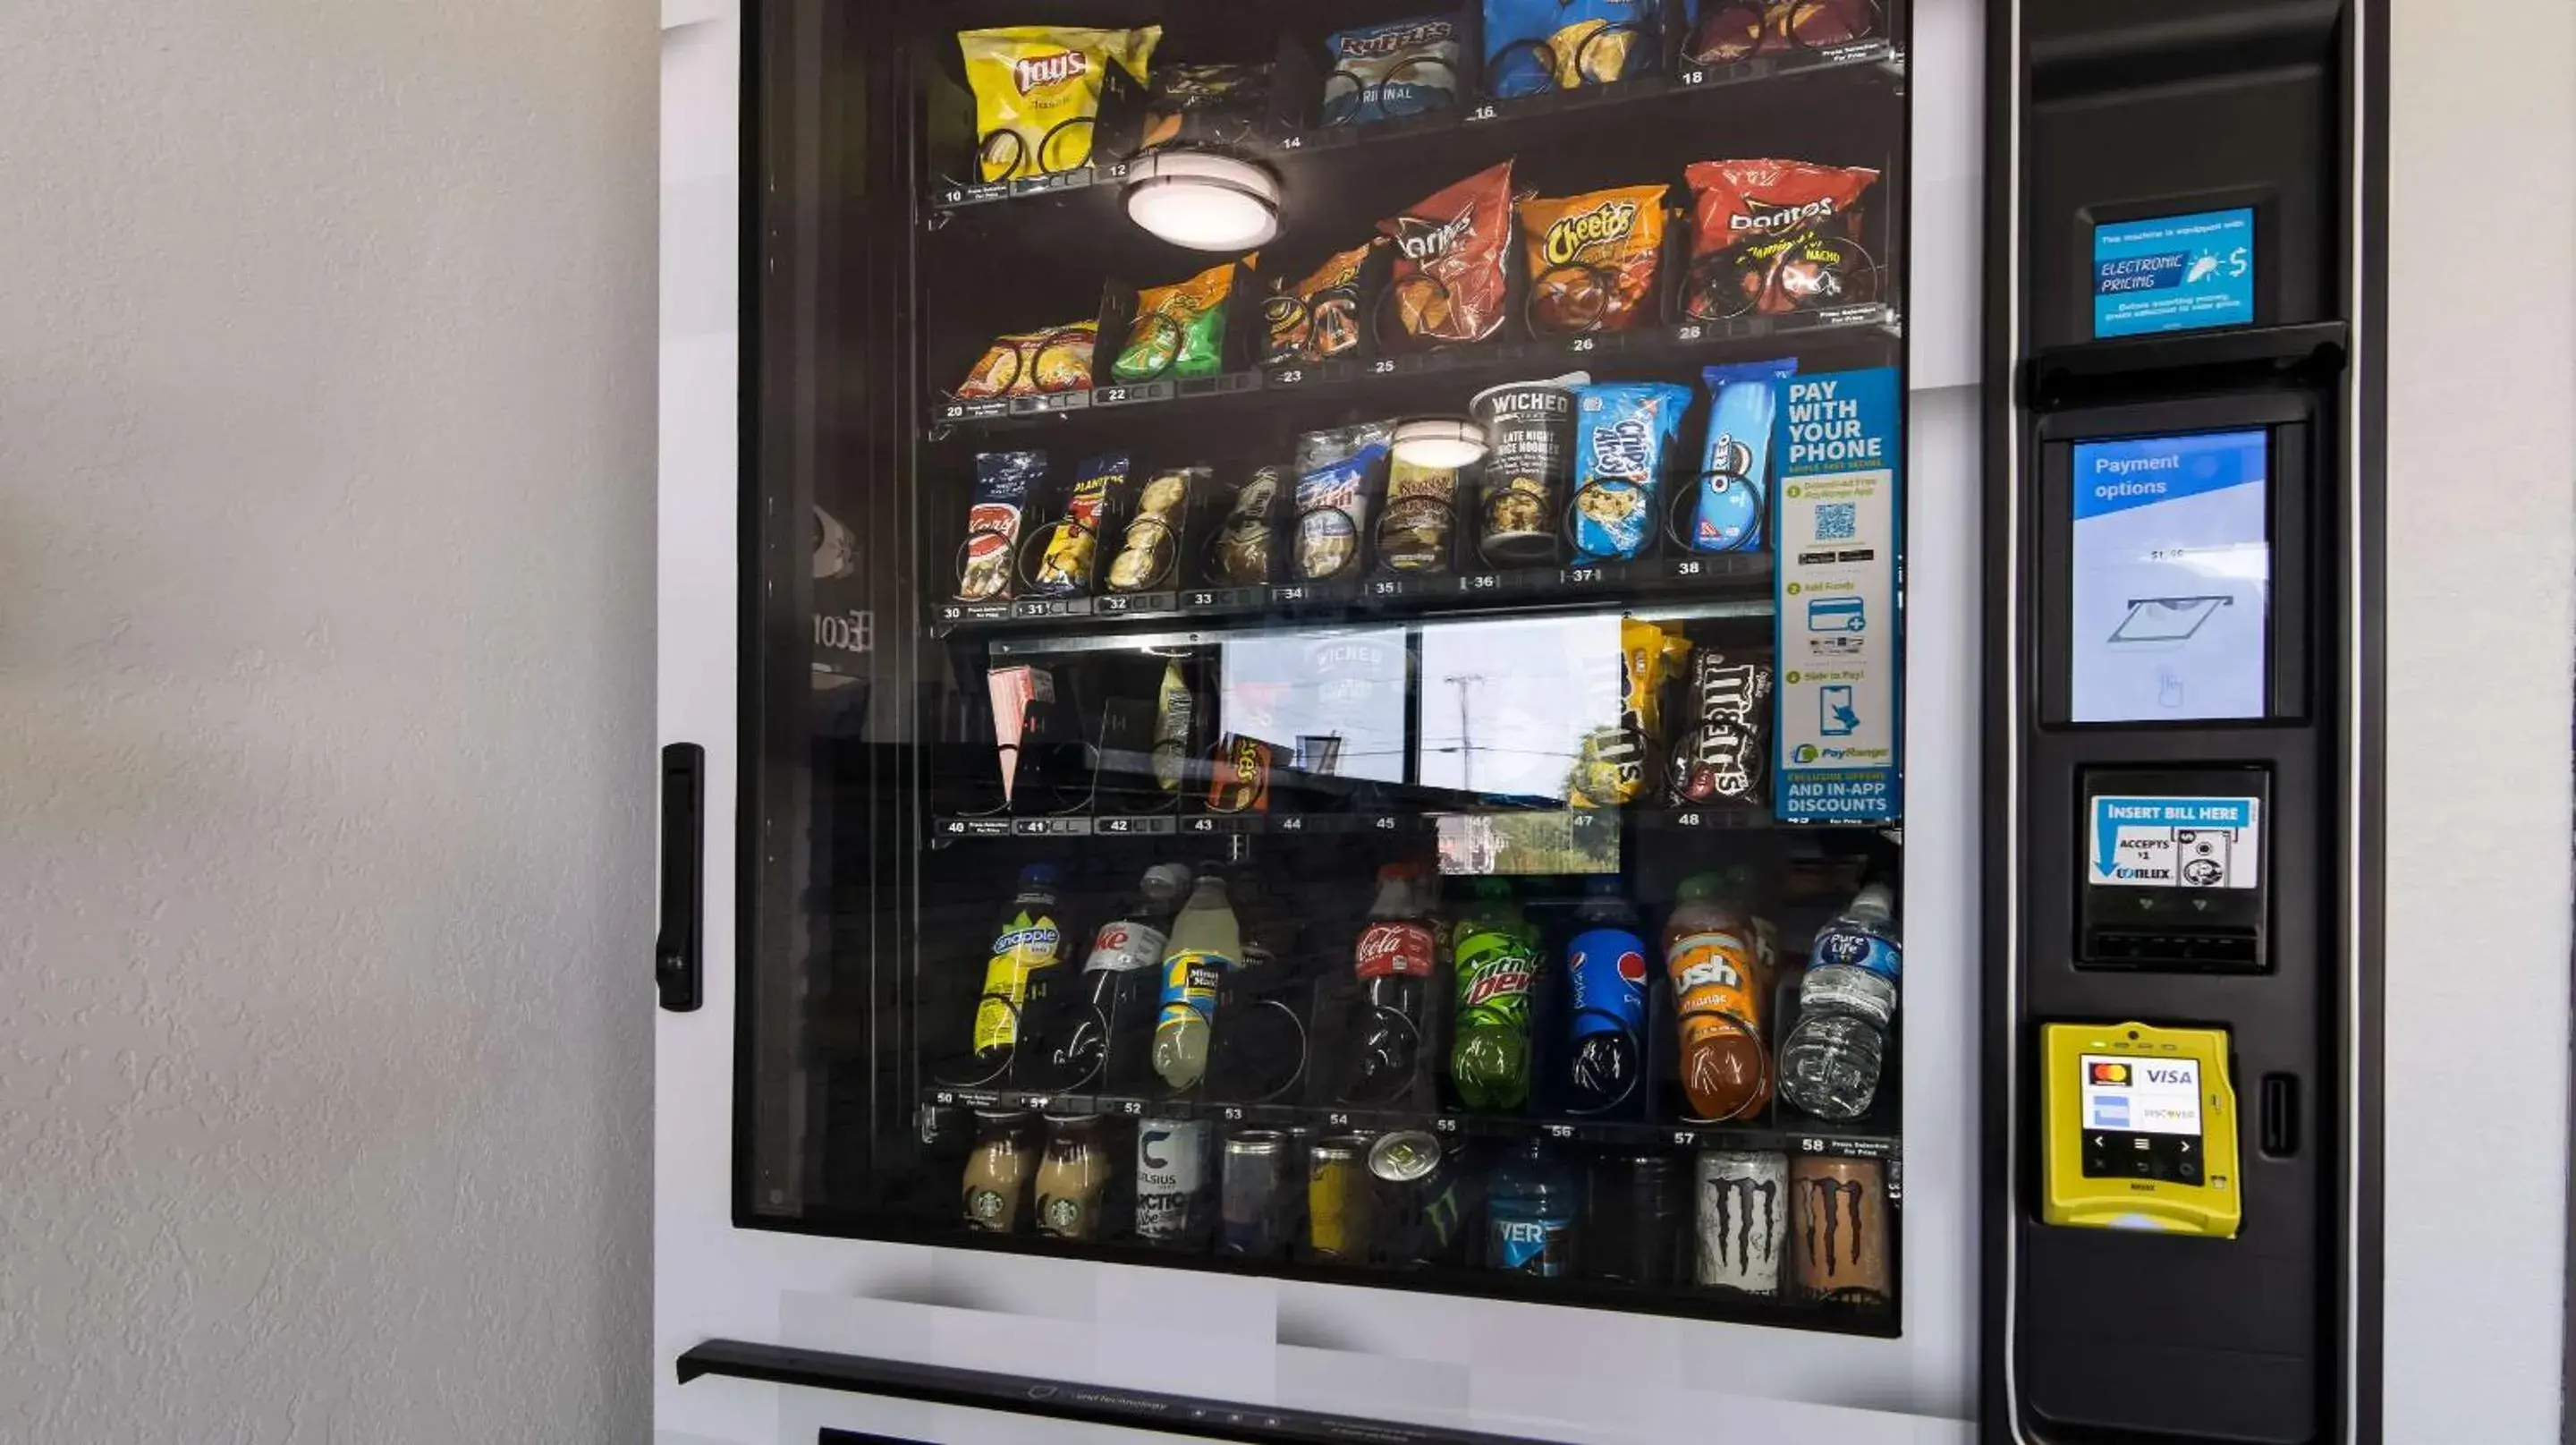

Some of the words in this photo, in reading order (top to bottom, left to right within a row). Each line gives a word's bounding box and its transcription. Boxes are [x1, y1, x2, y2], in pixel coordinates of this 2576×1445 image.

[1682, 72, 1703, 85] 18
[1476, 106, 1494, 119] 16
[1283, 136, 1301, 149] 14
[1109, 165, 1126, 176] 12
[945, 191, 962, 202] 10
[2101, 254, 2183, 276] ELECTRONIC
[2100, 275, 2155, 293] PRICING
[1573, 338, 1593, 352] 26
[1109, 389, 1125, 400] 22
[1790, 381, 1837, 402] PAY
[946, 405, 962, 417] 20
[1790, 399, 1857, 423] WITH
[1789, 421, 1861, 442] YOUR
[1790, 438, 1882, 463] PHONE
[1709, 432, 1733, 494] OREO
[2095, 454, 2181, 475] Payment
[2095, 480, 2168, 501] options
[1679, 563, 1699, 574] 38
[1474, 576, 1493, 587] 36
[1573, 570, 1591, 582] 37
[1195, 594, 1212, 604] 33
[1285, 588, 1302, 599] 34
[945, 607, 960, 618] 30
[1028, 603, 1043, 615] 31
[1789, 784, 1823, 796] AND
[1827, 783, 1885, 795] IN-APP
[1788, 797, 1887, 812] DISCOUNTS
[2108, 803, 2160, 820] INSERT
[2165, 806, 2196, 820] BILL
[2199, 806, 2239, 820] HERE
[1110, 820, 1127, 831] 42
[1195, 820, 1212, 830] 43
[1284, 819, 1301, 829] 44
[1377, 818, 1395, 829] 45
[1574, 815, 1592, 827] 47
[1679, 813, 1699, 826] 48
[948, 822, 964, 833] 40
[2120, 839, 2170, 849] ACCEPTS
[1829, 933, 1865, 945] Pure
[1831, 943, 1859, 955] Life
[2147, 1069, 2192, 1084] VISA
[937, 1092, 952, 1103] 50
[1123, 1102, 1140, 1114] 52
[1330, 1115, 1348, 1126] 54
[1438, 1120, 1455, 1132] 55
[1674, 1131, 1695, 1144] 57
[1802, 1139, 1823, 1152] 58
